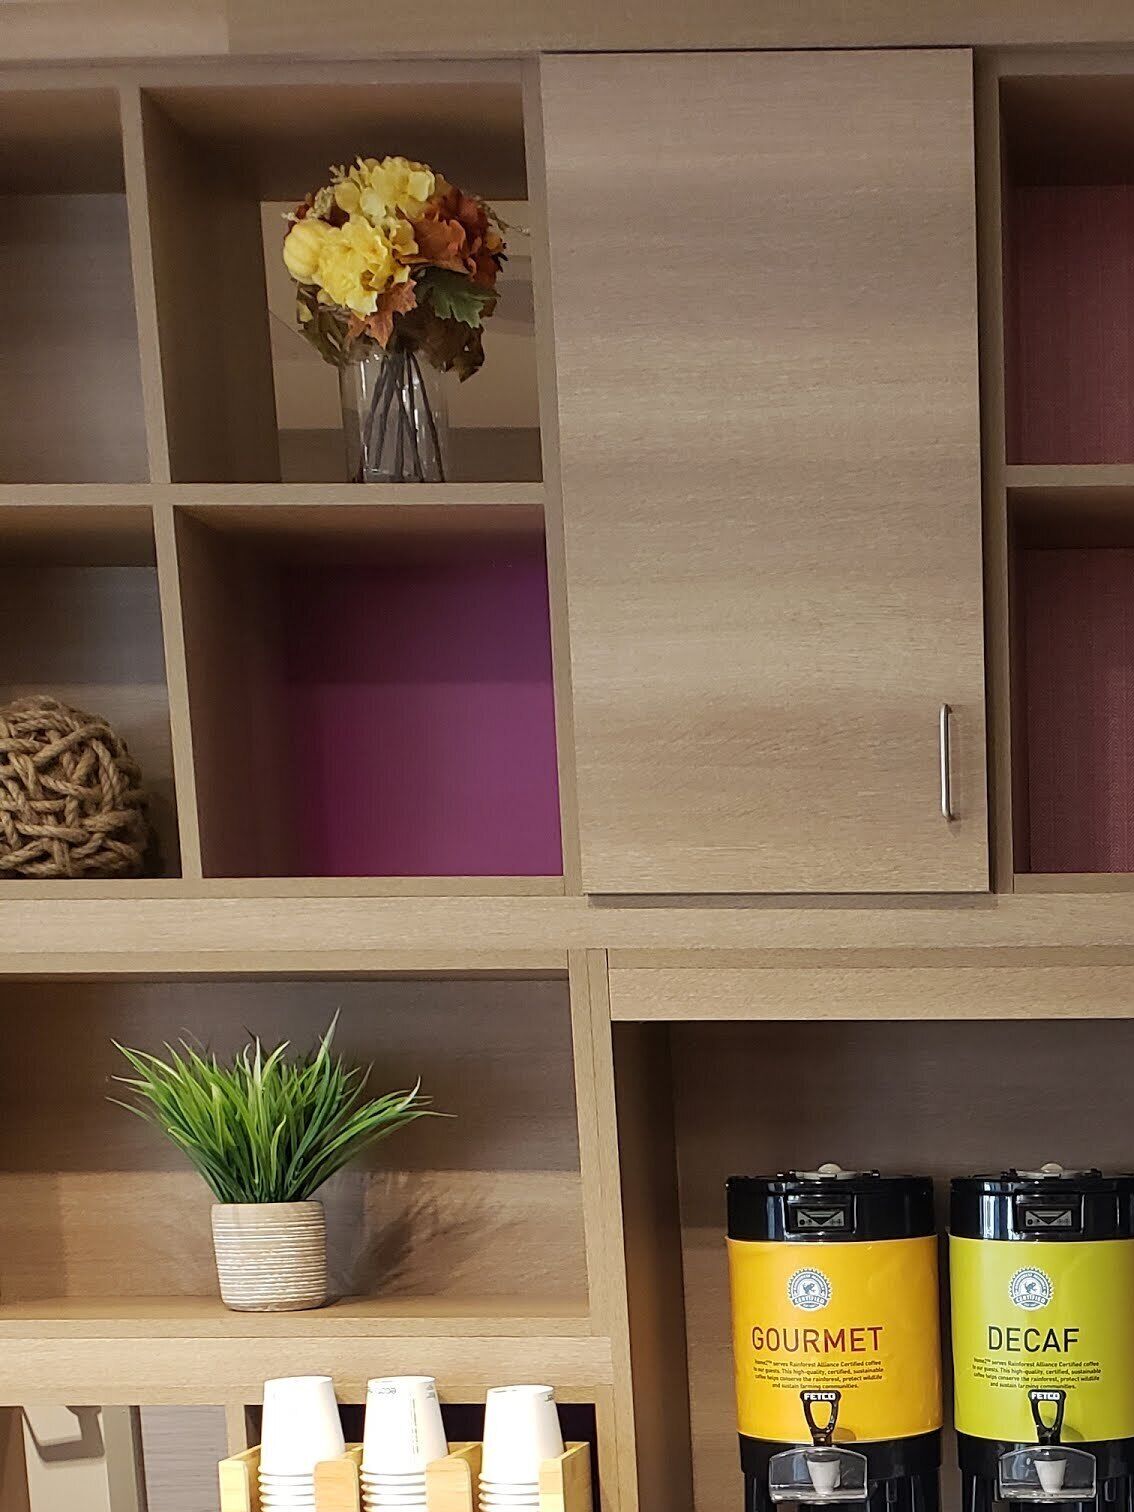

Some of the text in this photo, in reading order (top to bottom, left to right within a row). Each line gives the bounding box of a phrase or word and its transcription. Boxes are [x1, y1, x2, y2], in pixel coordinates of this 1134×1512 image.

[752, 1326, 883, 1353] GOURMET
[988, 1326, 1079, 1353] DECAF
[803, 1392, 836, 1401] FETCO
[1031, 1391, 1061, 1400] FETCO
